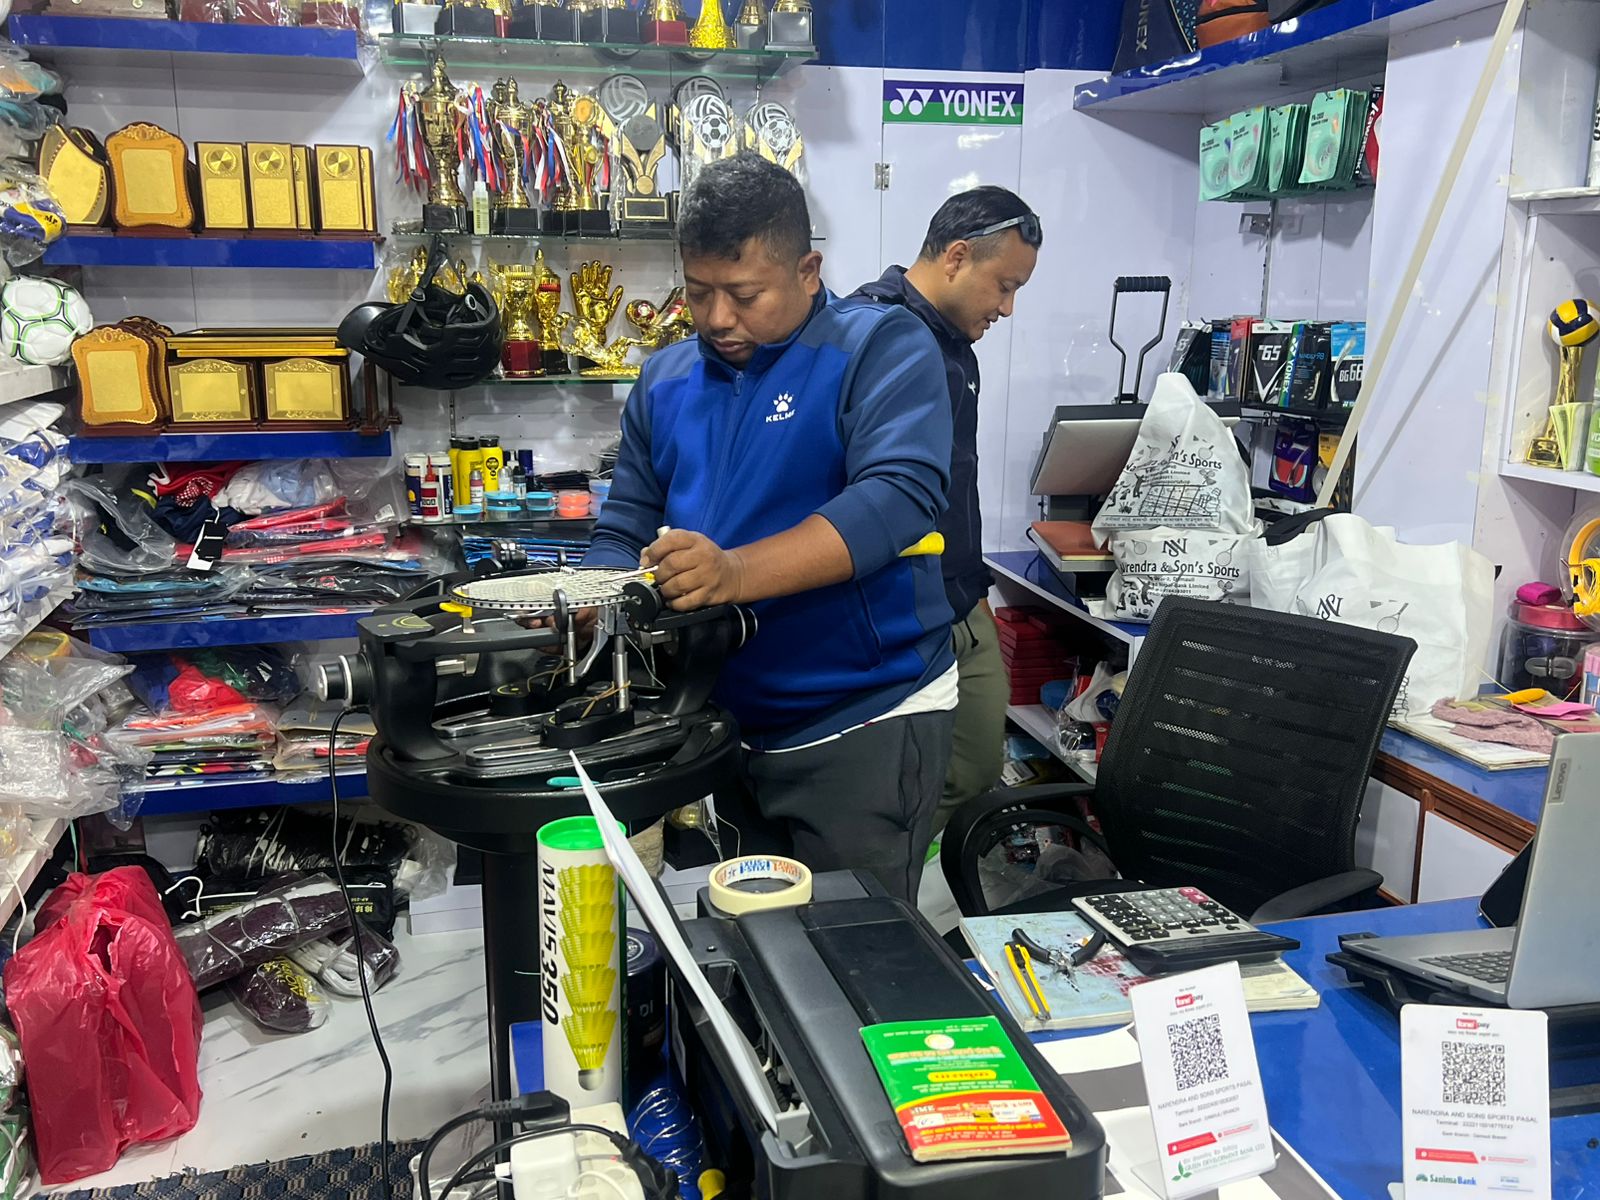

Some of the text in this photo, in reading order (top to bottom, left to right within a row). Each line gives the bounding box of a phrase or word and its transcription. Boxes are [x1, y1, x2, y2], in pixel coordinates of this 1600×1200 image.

[939, 89, 1016, 117] YONEX
[1283, 359, 1294, 393] YONEX
[1189, 453, 1223, 469] Sports
[1174, 560, 1203, 574] Son's
[1207, 562, 1240, 578] Sports
[1552, 762, 1567, 800] Lenovo
[541, 860, 559, 1026] MAVIS 350
[1412, 1108, 1449, 1117] NARENDRA
[1451, 1110, 1465, 1118] AND
[1488, 1113, 1515, 1121] SPORTS
[1516, 1115, 1538, 1123] PASAL
